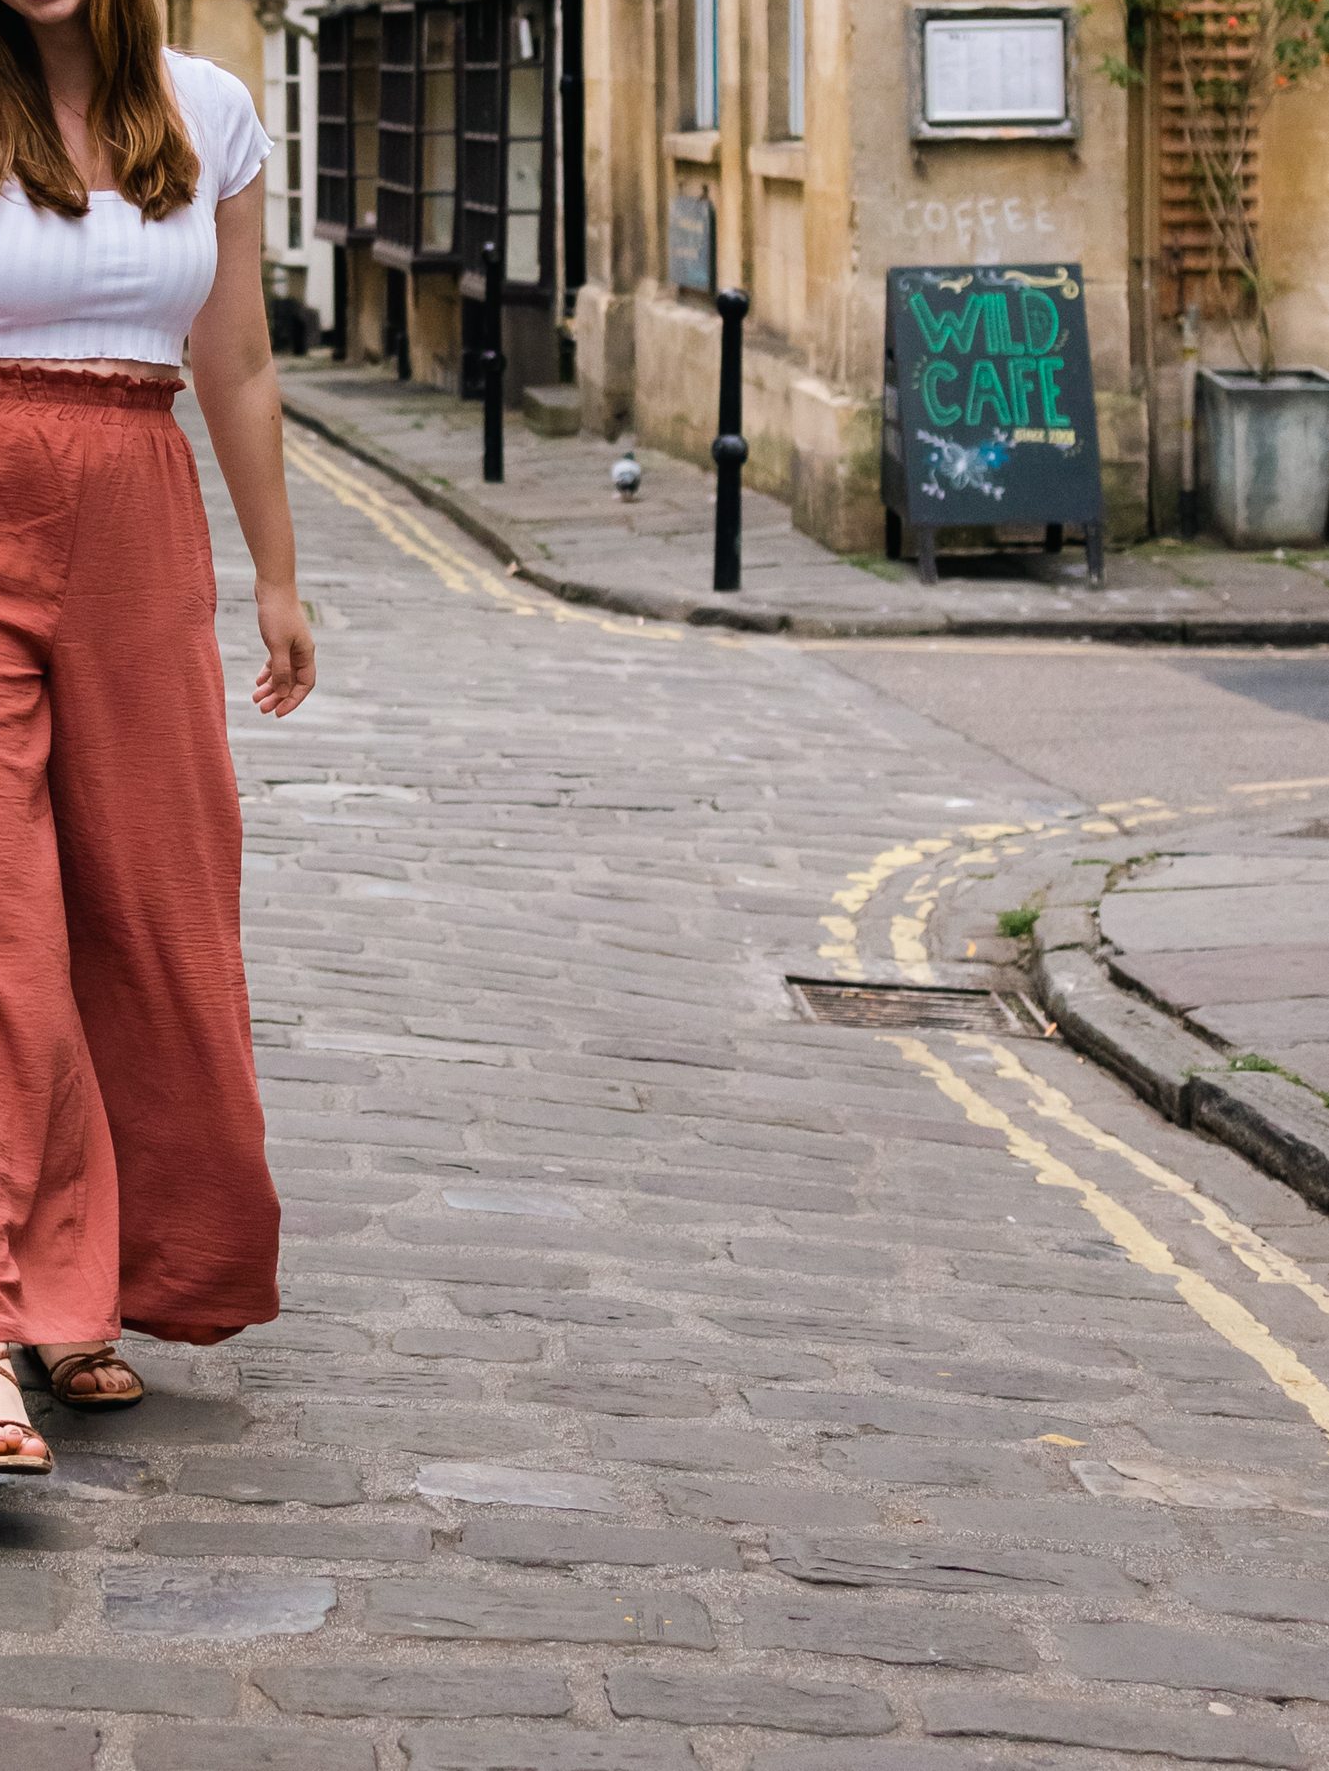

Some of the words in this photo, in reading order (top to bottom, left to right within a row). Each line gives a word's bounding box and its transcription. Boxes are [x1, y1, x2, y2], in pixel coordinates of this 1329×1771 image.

[902, 196, 1056, 235] COFFEE
[909, 289, 1059, 354] WILD
[924, 357, 1071, 427] CAFE
